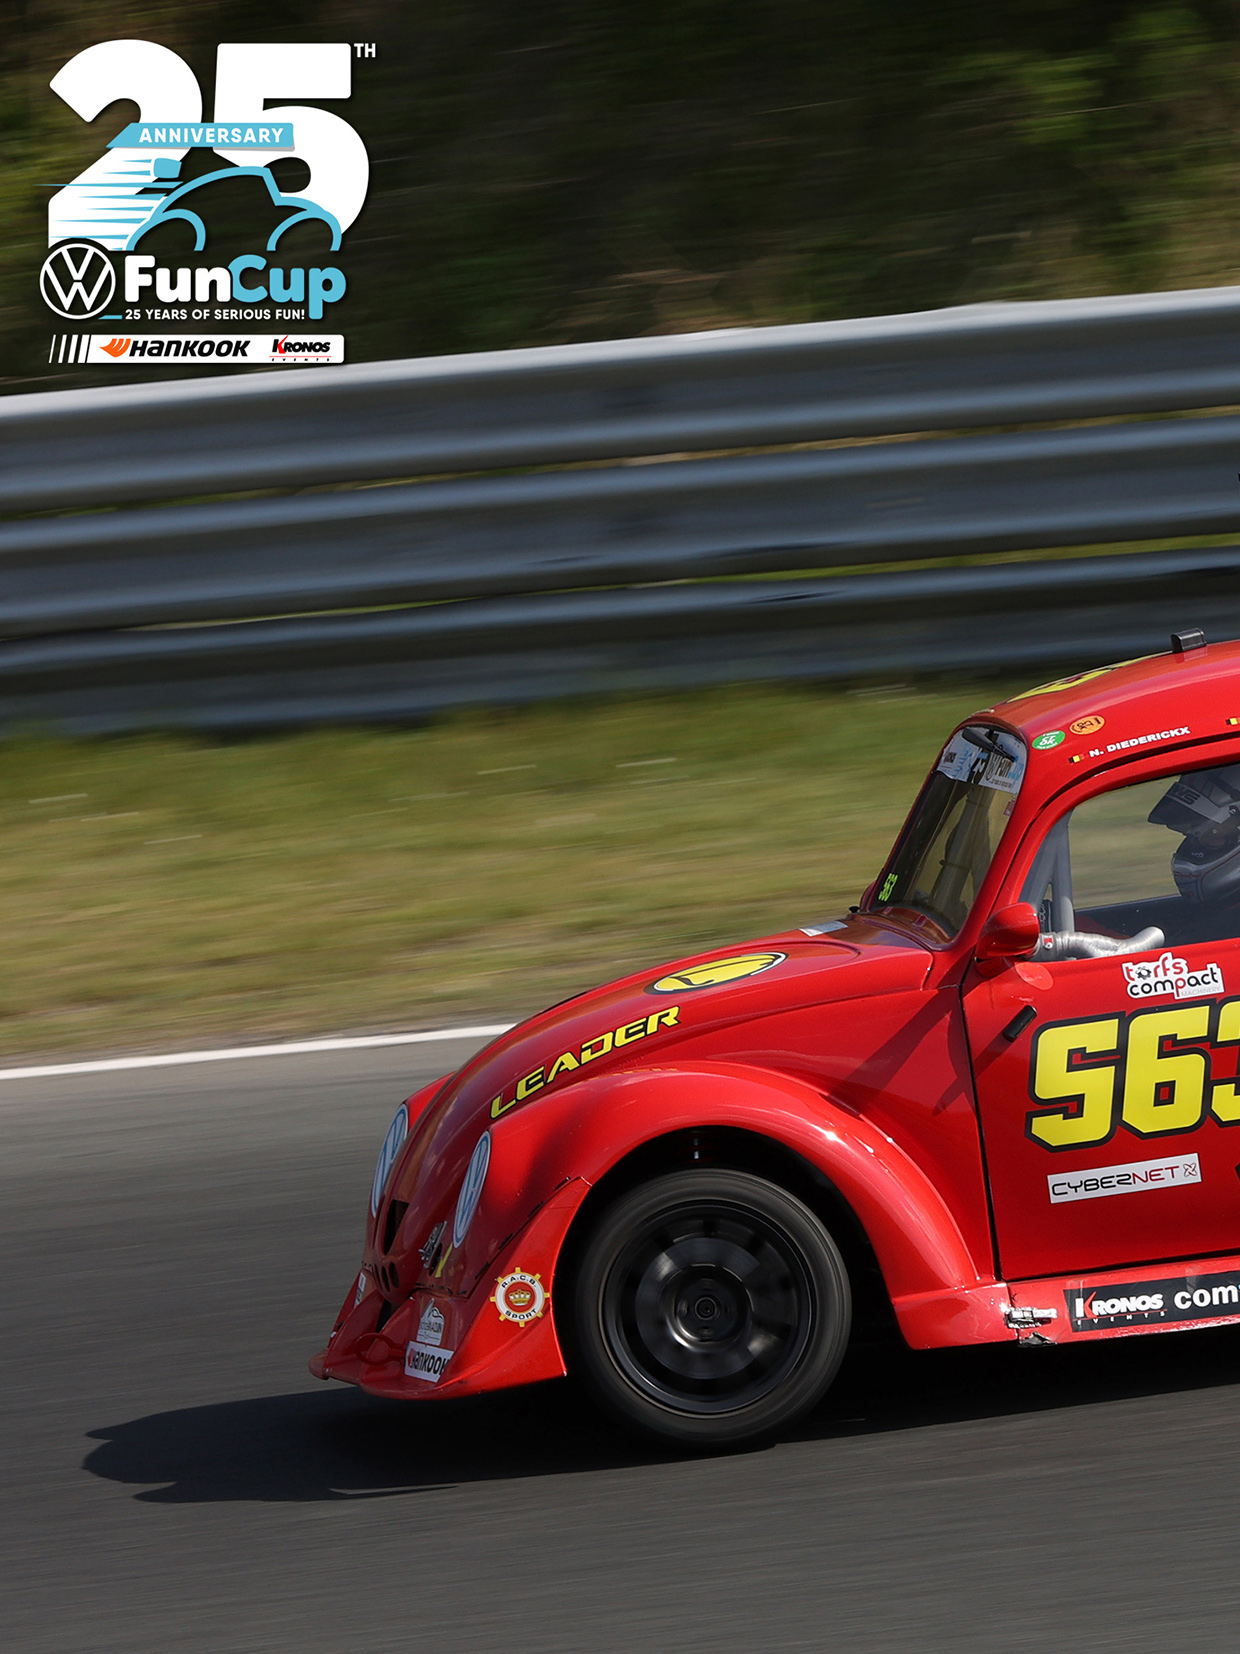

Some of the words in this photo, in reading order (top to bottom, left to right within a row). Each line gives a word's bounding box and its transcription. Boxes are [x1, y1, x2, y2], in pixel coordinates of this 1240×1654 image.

[1088, 748, 1105, 758] N.
[1106, 726, 1191, 753] DIEDERICKX
[1129, 967, 1219, 998] compact
[1181, 986, 1221, 997] MACHINERY
[489, 1005, 682, 1120] LEADER
[505, 1307, 537, 1320] SPORT
[1075, 1291, 1164, 1318] KRONOS
